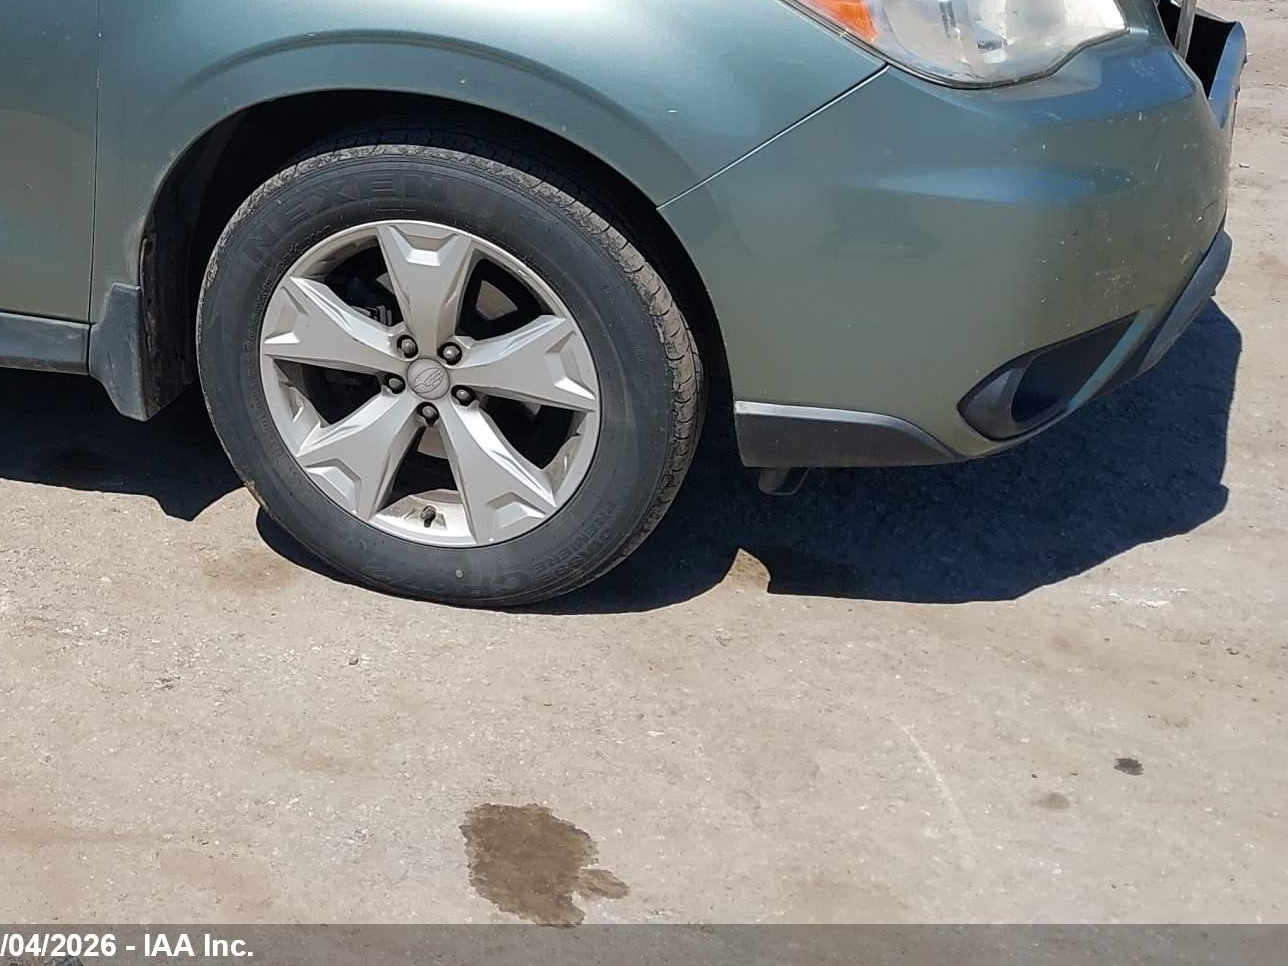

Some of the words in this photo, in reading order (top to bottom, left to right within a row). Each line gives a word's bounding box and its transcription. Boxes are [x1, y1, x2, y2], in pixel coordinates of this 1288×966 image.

[242, 172, 448, 266] NEXEN
[534, 500, 616, 572] PREMIERE
[542, 528, 611, 583] CLASSE
